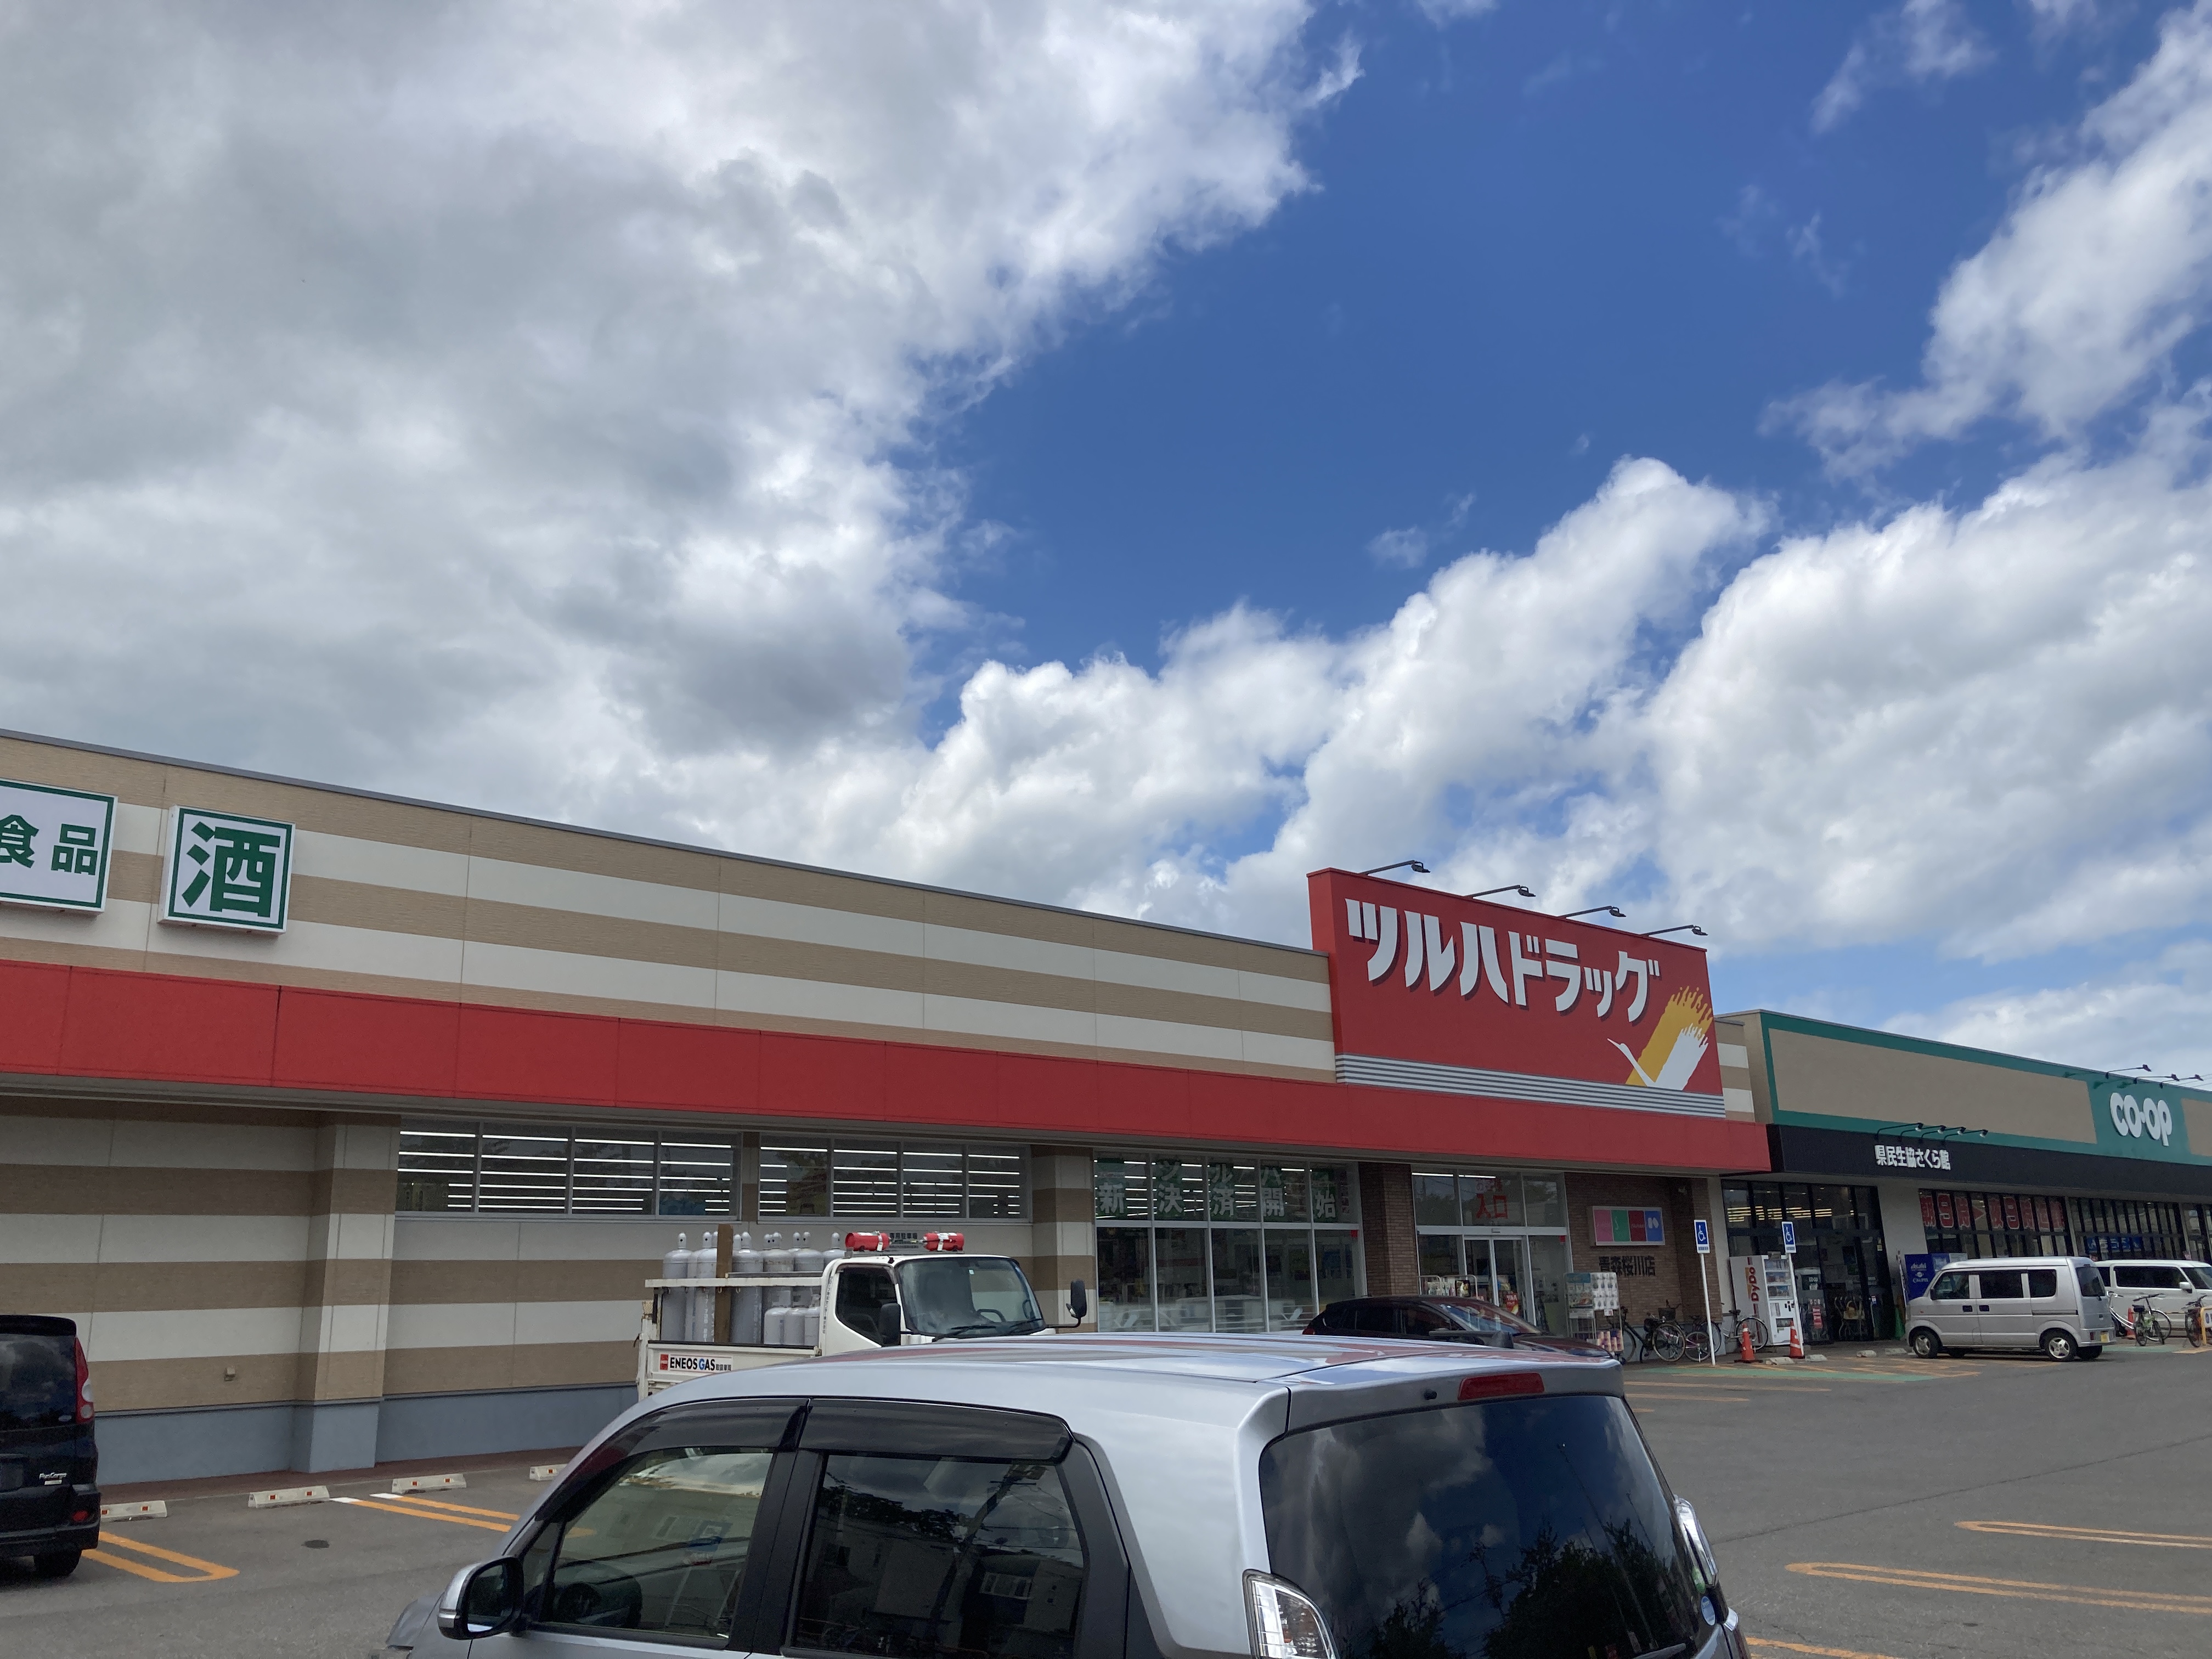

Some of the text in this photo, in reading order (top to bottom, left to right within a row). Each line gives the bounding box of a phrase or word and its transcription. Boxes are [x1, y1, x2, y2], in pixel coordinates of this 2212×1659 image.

[0, 814, 98, 876] 食品
[182, 821, 280, 917] 酒
[1345, 898, 1661, 1023] ツルハドラッグ
[1875, 1144, 1951, 1171] 県民生協さくら館
[1097, 1182, 1336, 1219] 新決済開始
[1476, 1193, 1508, 1218] 入口
[1599, 1255, 1656, 1276] 青森桜川店
[1749, 1267, 1760, 1301] DyDo
[670, 1357, 698, 1369] ENEOS
[698, 1358, 715, 1371] GAS
